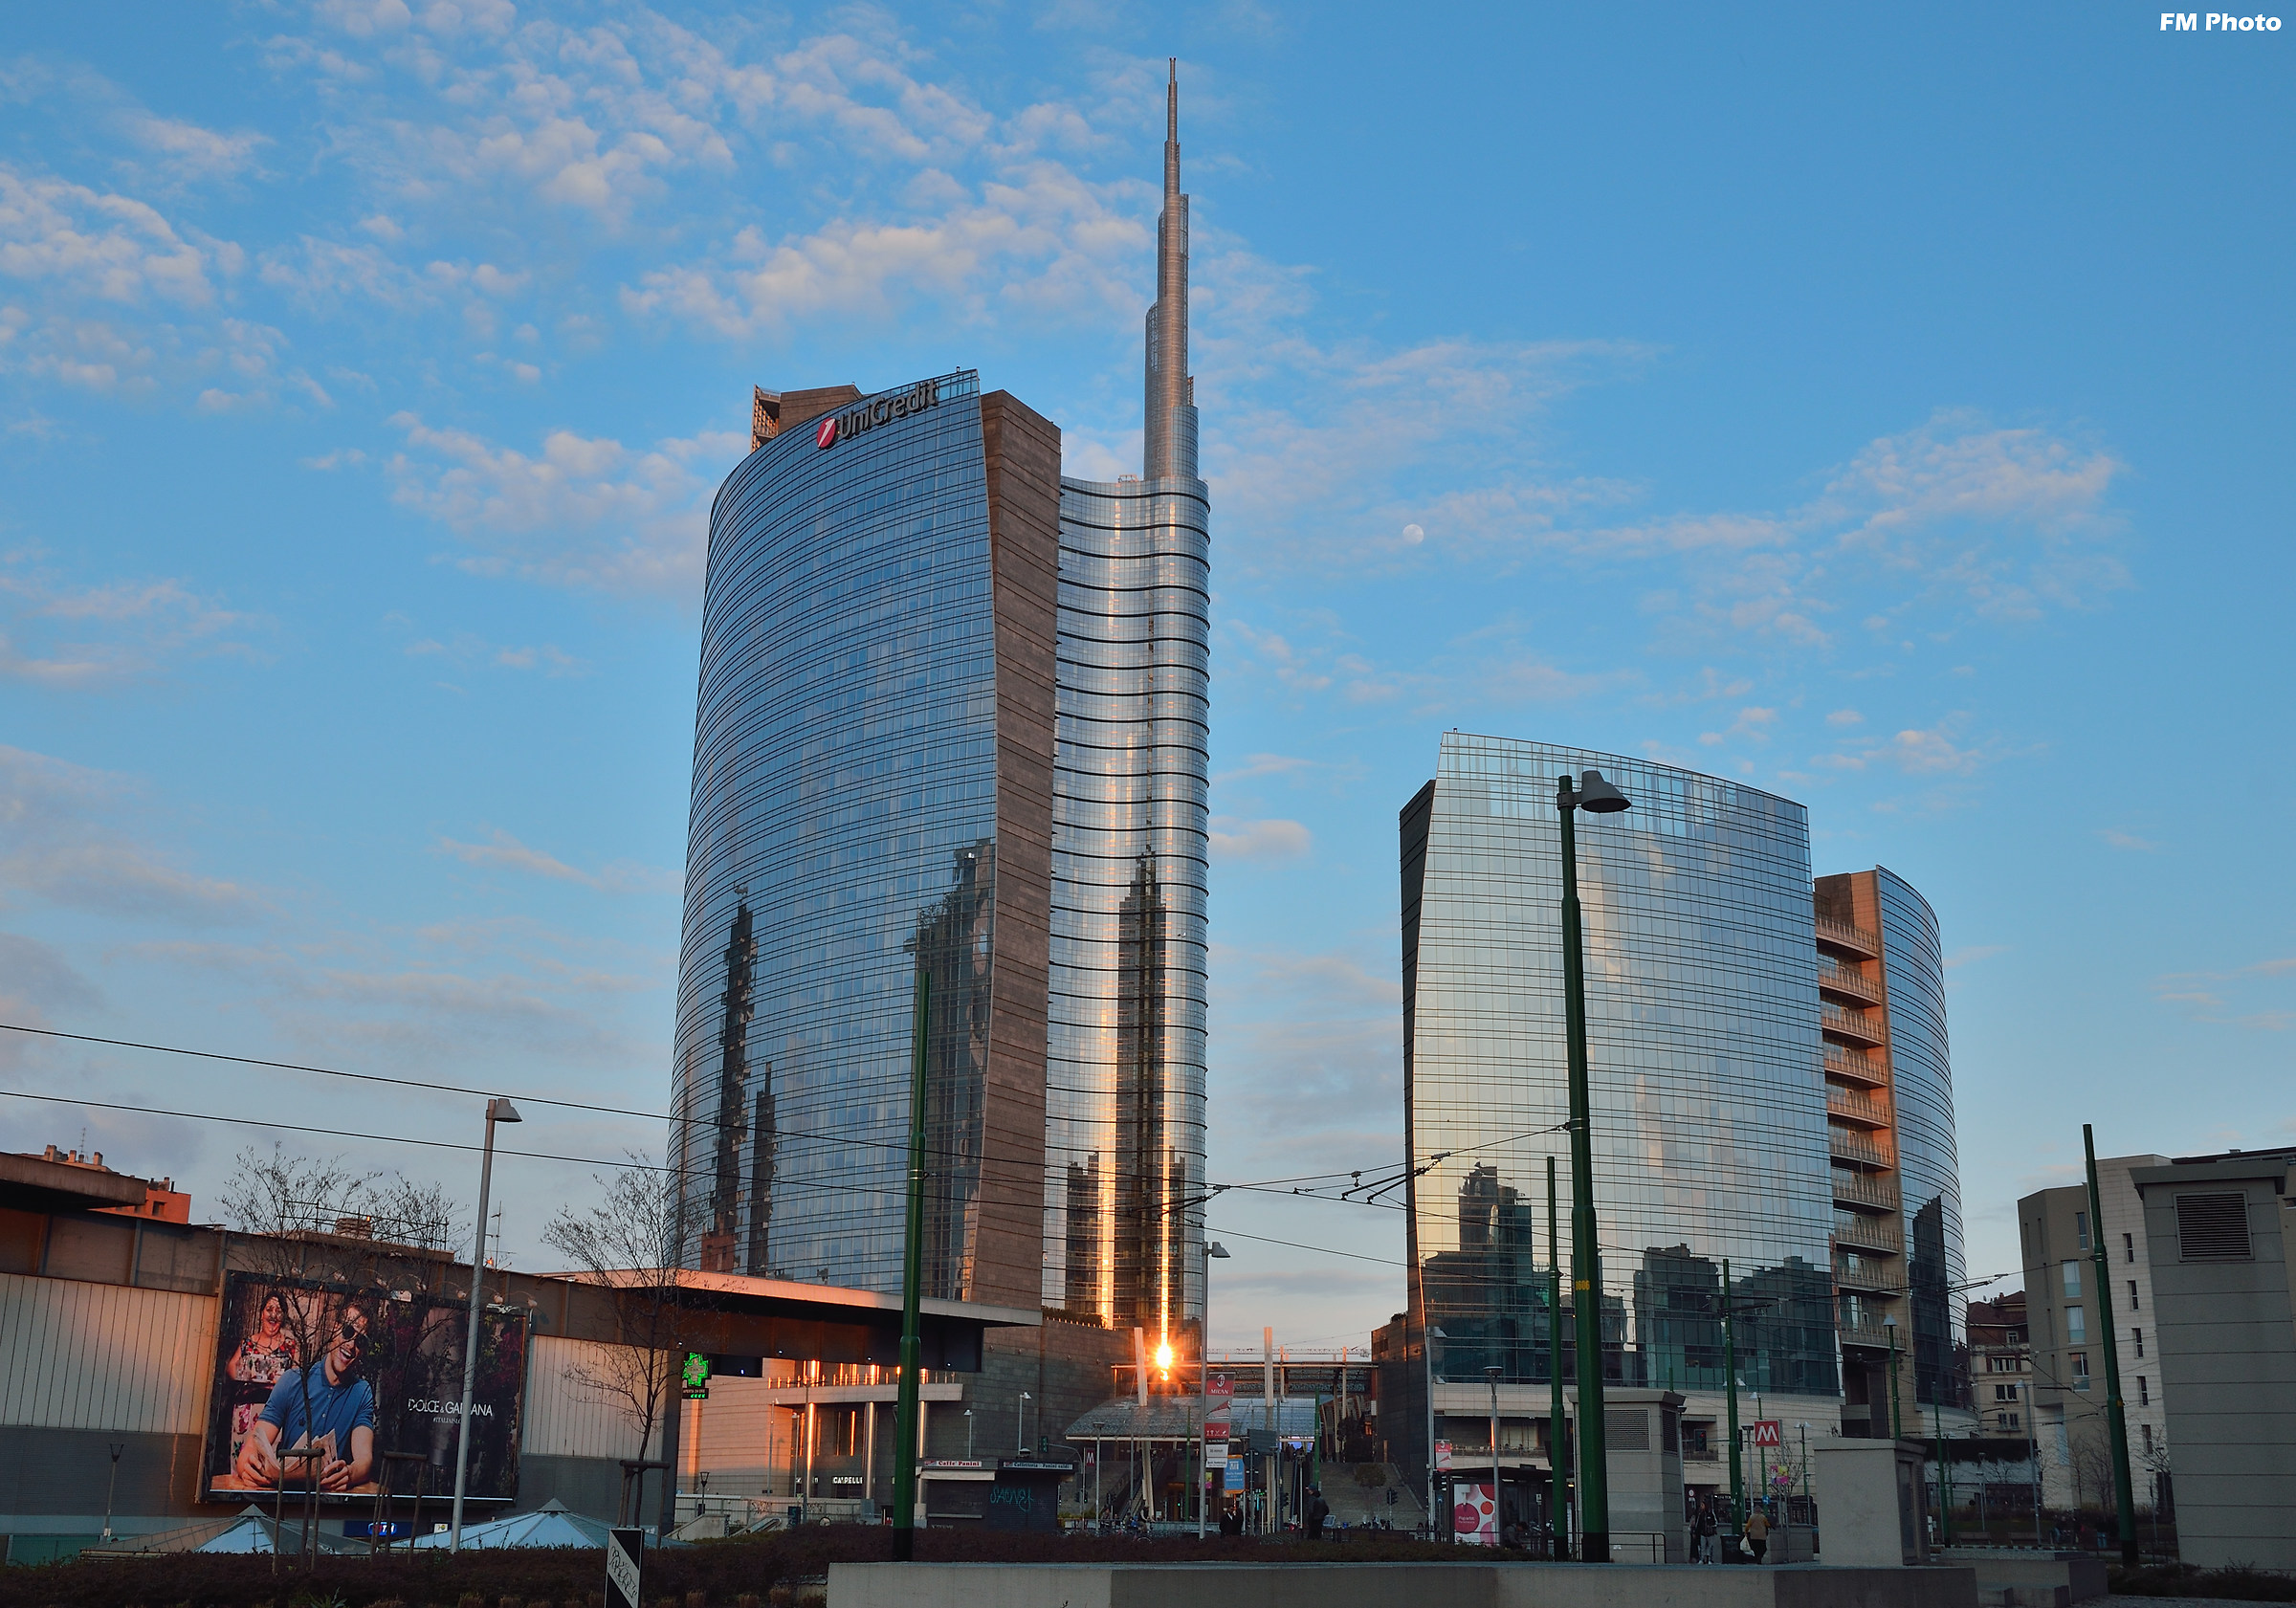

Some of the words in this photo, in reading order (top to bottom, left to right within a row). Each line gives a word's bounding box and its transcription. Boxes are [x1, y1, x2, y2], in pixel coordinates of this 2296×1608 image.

[839, 379, 939, 440] UniCredit
[408, 1399, 440, 1413] DOLCE
[445, 1401, 493, 1416] GAANA
[1756, 1425, 1778, 1442] M
[1086, 1452, 1094, 1464] M
